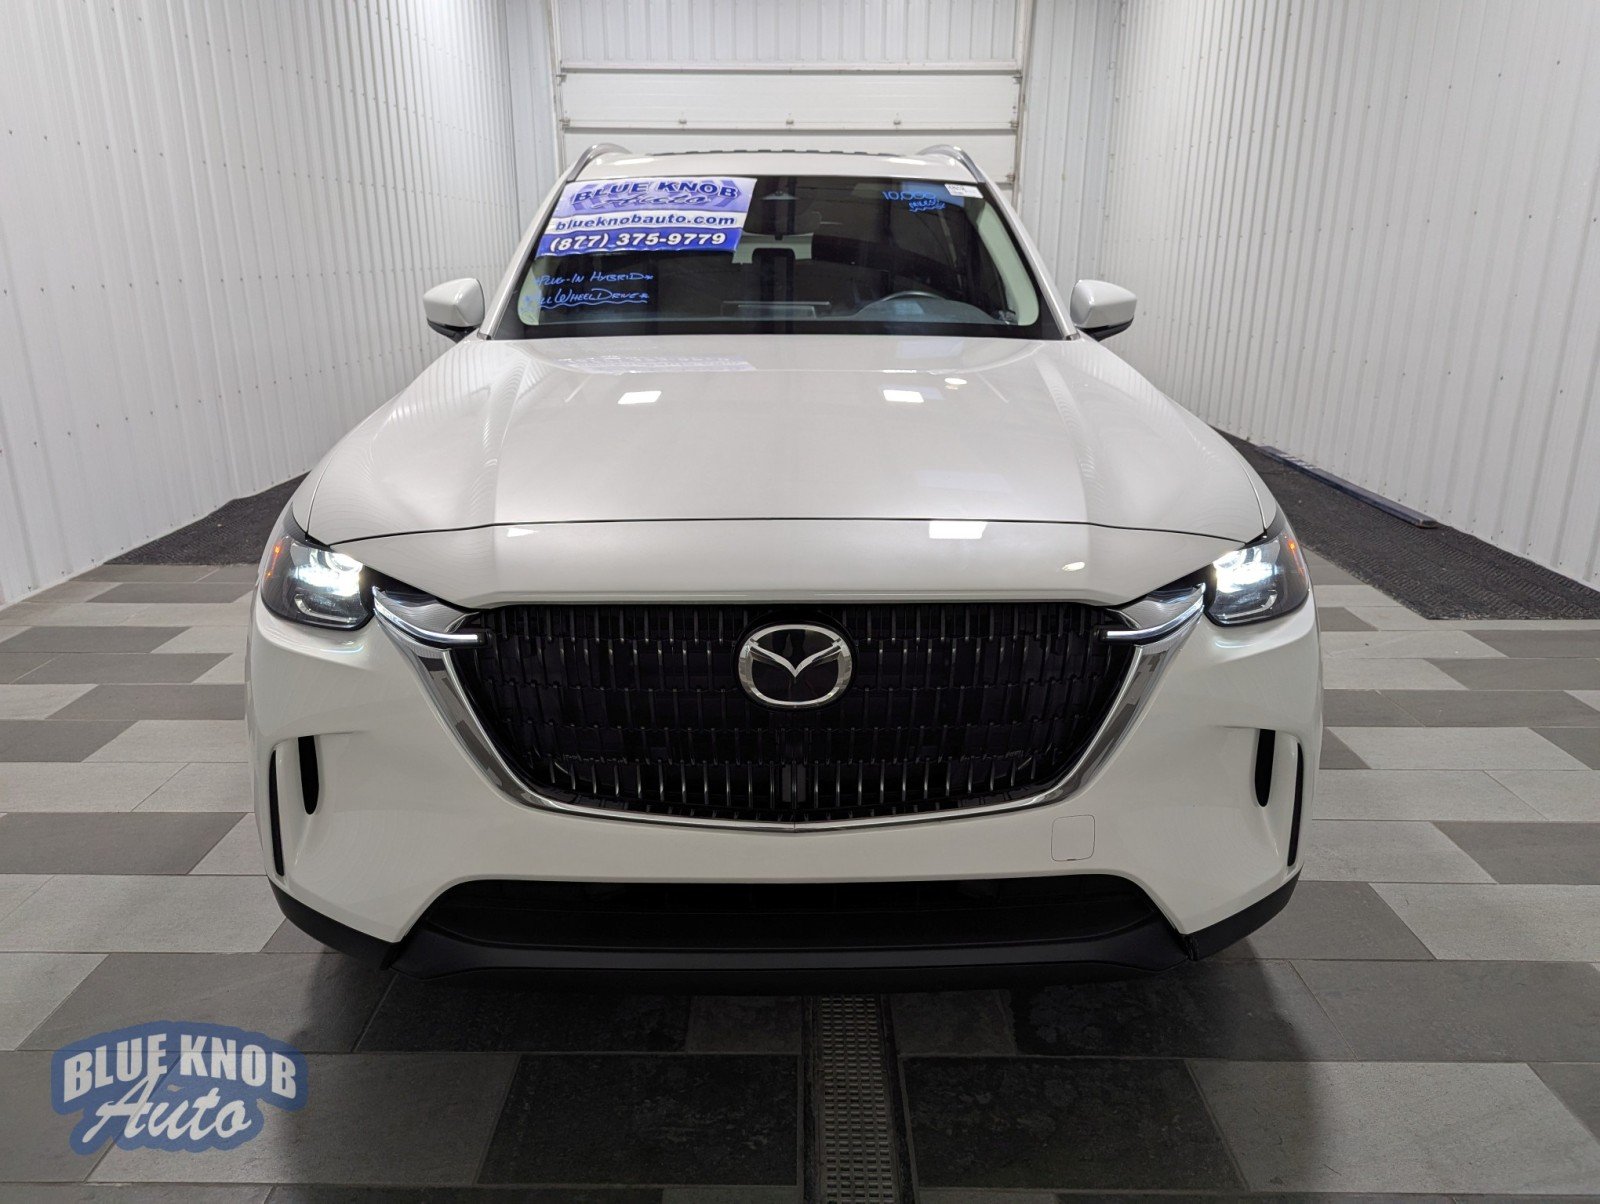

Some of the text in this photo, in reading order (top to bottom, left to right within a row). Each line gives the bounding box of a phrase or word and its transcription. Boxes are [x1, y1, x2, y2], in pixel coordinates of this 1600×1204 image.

[573, 181, 738, 204] BLUE KNOB
[591, 193, 712, 209] Auto
[555, 214, 736, 231] blueknobauto.com
[550, 232, 727, 252] (877) 375-9779
